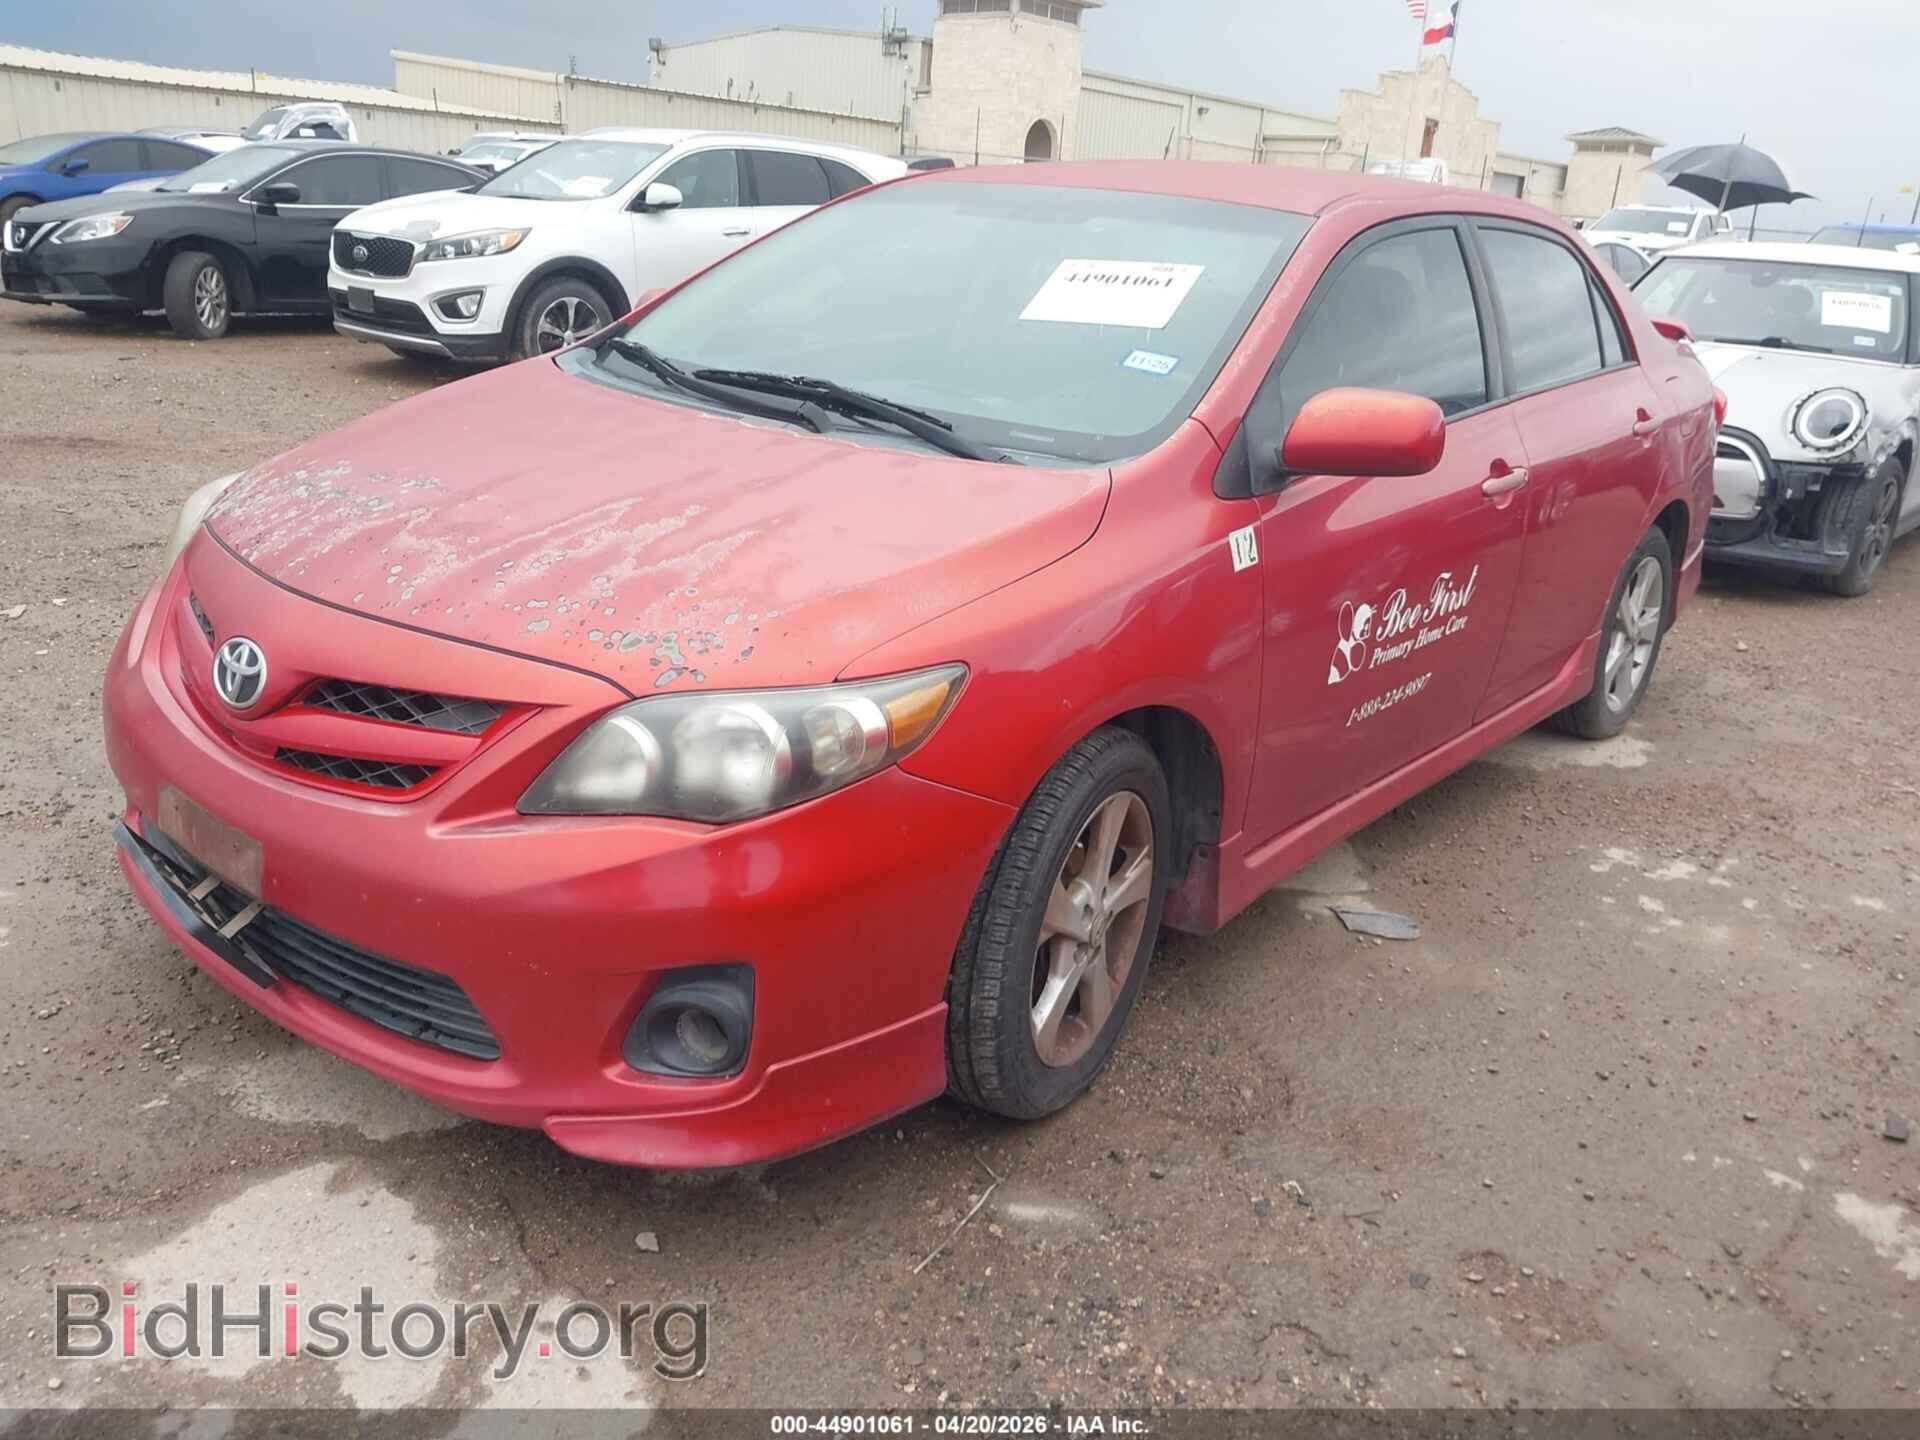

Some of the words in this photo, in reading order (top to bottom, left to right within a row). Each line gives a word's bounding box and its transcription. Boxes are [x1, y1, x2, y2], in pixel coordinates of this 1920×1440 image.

[1376, 588, 1422, 641] Bee
[1422, 564, 1479, 623] First
[1368, 638, 1415, 670] Primary
[1413, 625, 1445, 650] Home
[1445, 614, 1469, 636] Care
